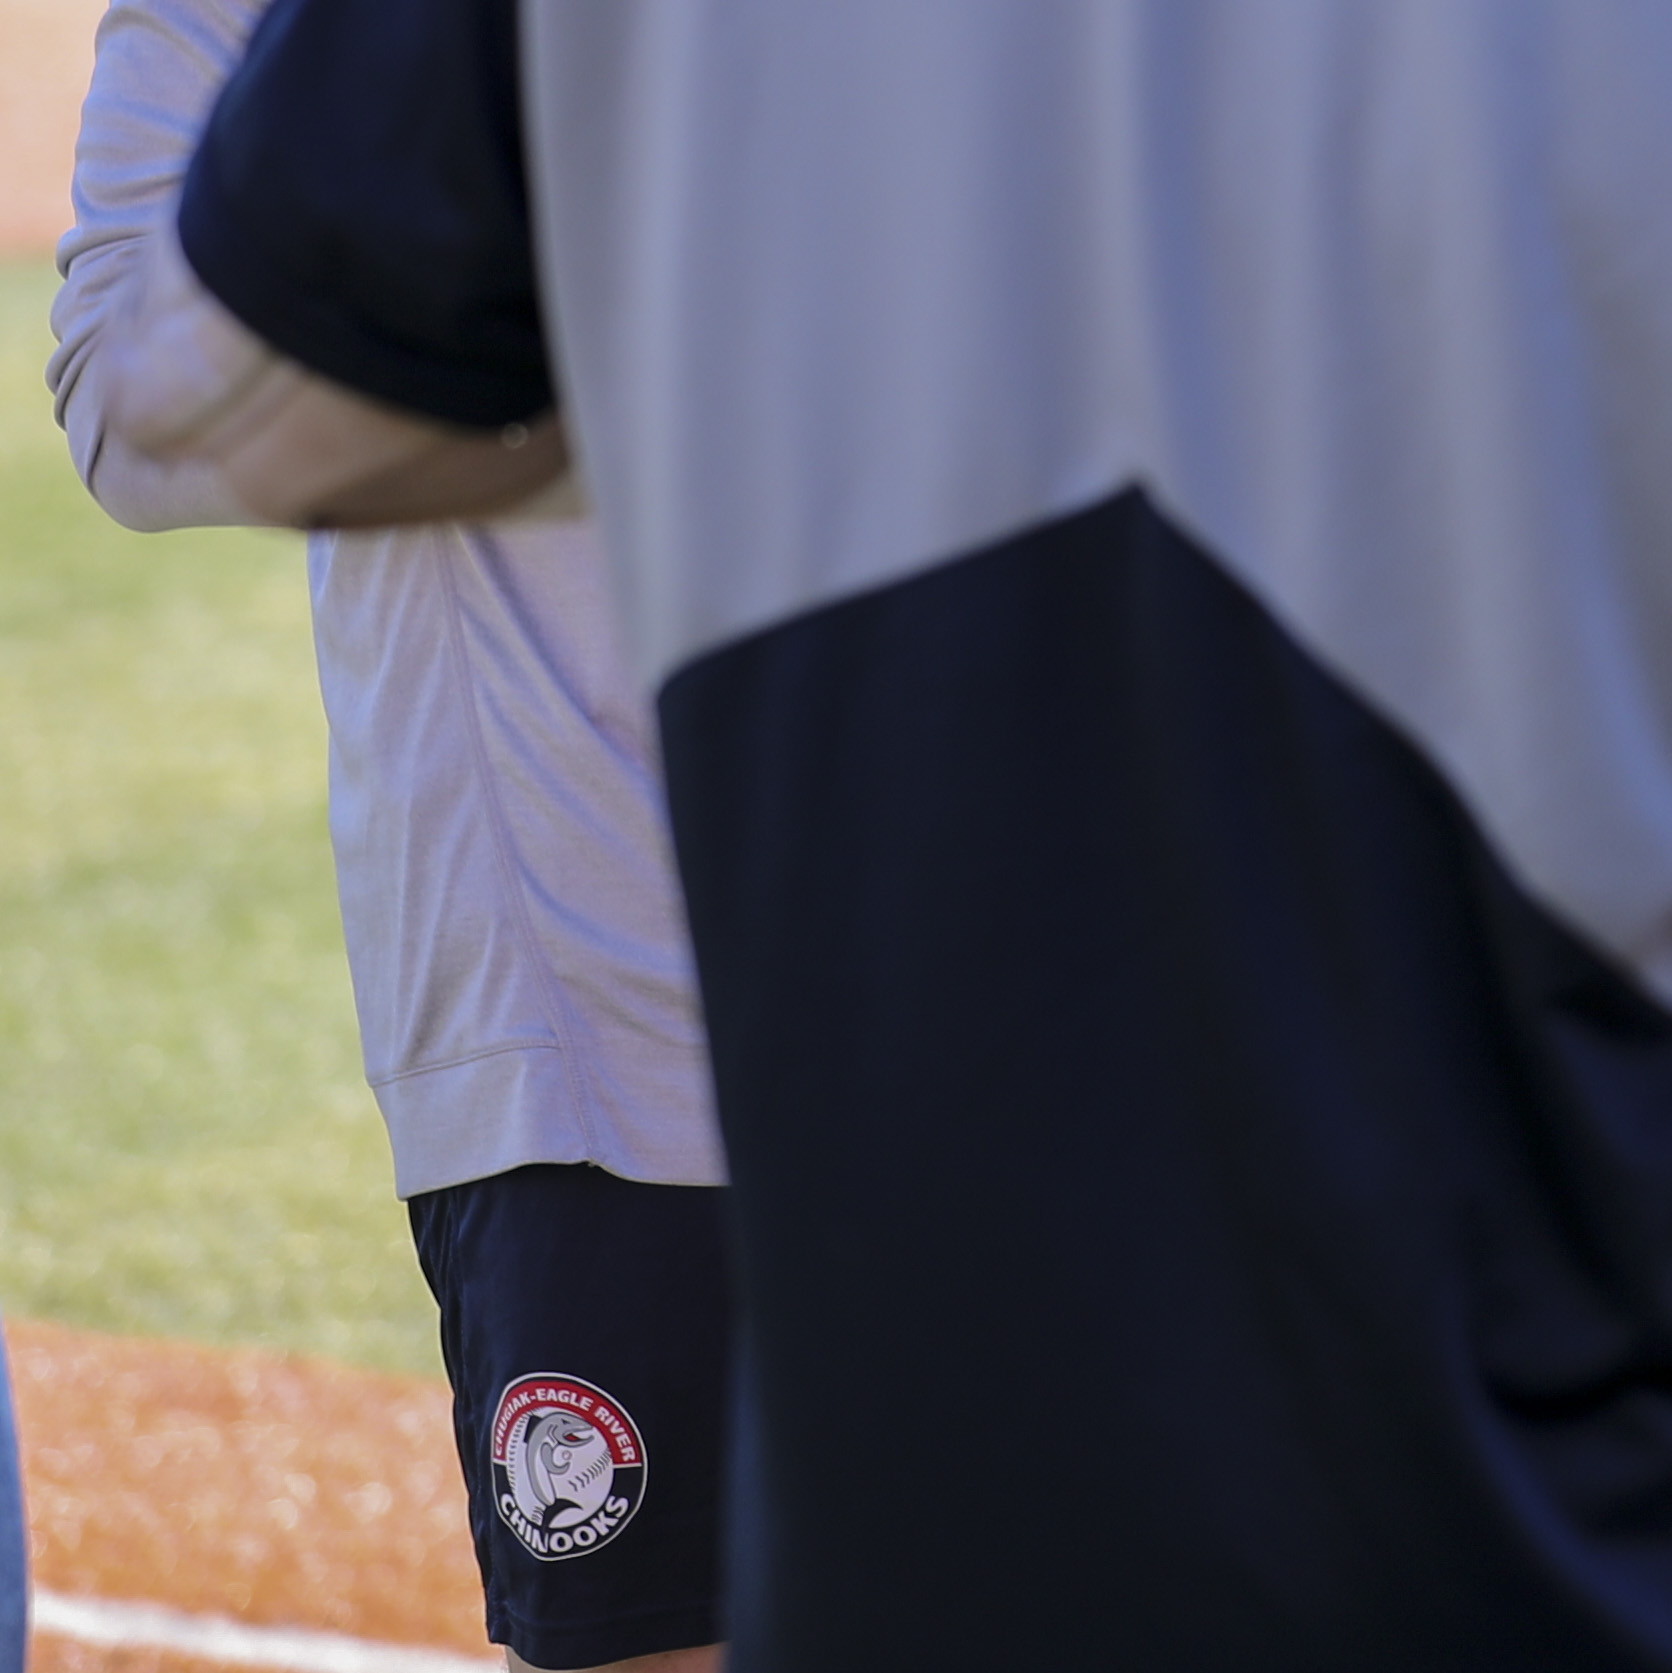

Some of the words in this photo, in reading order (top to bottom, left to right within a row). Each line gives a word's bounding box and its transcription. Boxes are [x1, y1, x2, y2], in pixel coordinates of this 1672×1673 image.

[494, 1387, 594, 1457] CHUGIAK-EAGLE
[594, 1405, 637, 1463] RIVER
[499, 1492, 630, 1554] CHINOOKS
